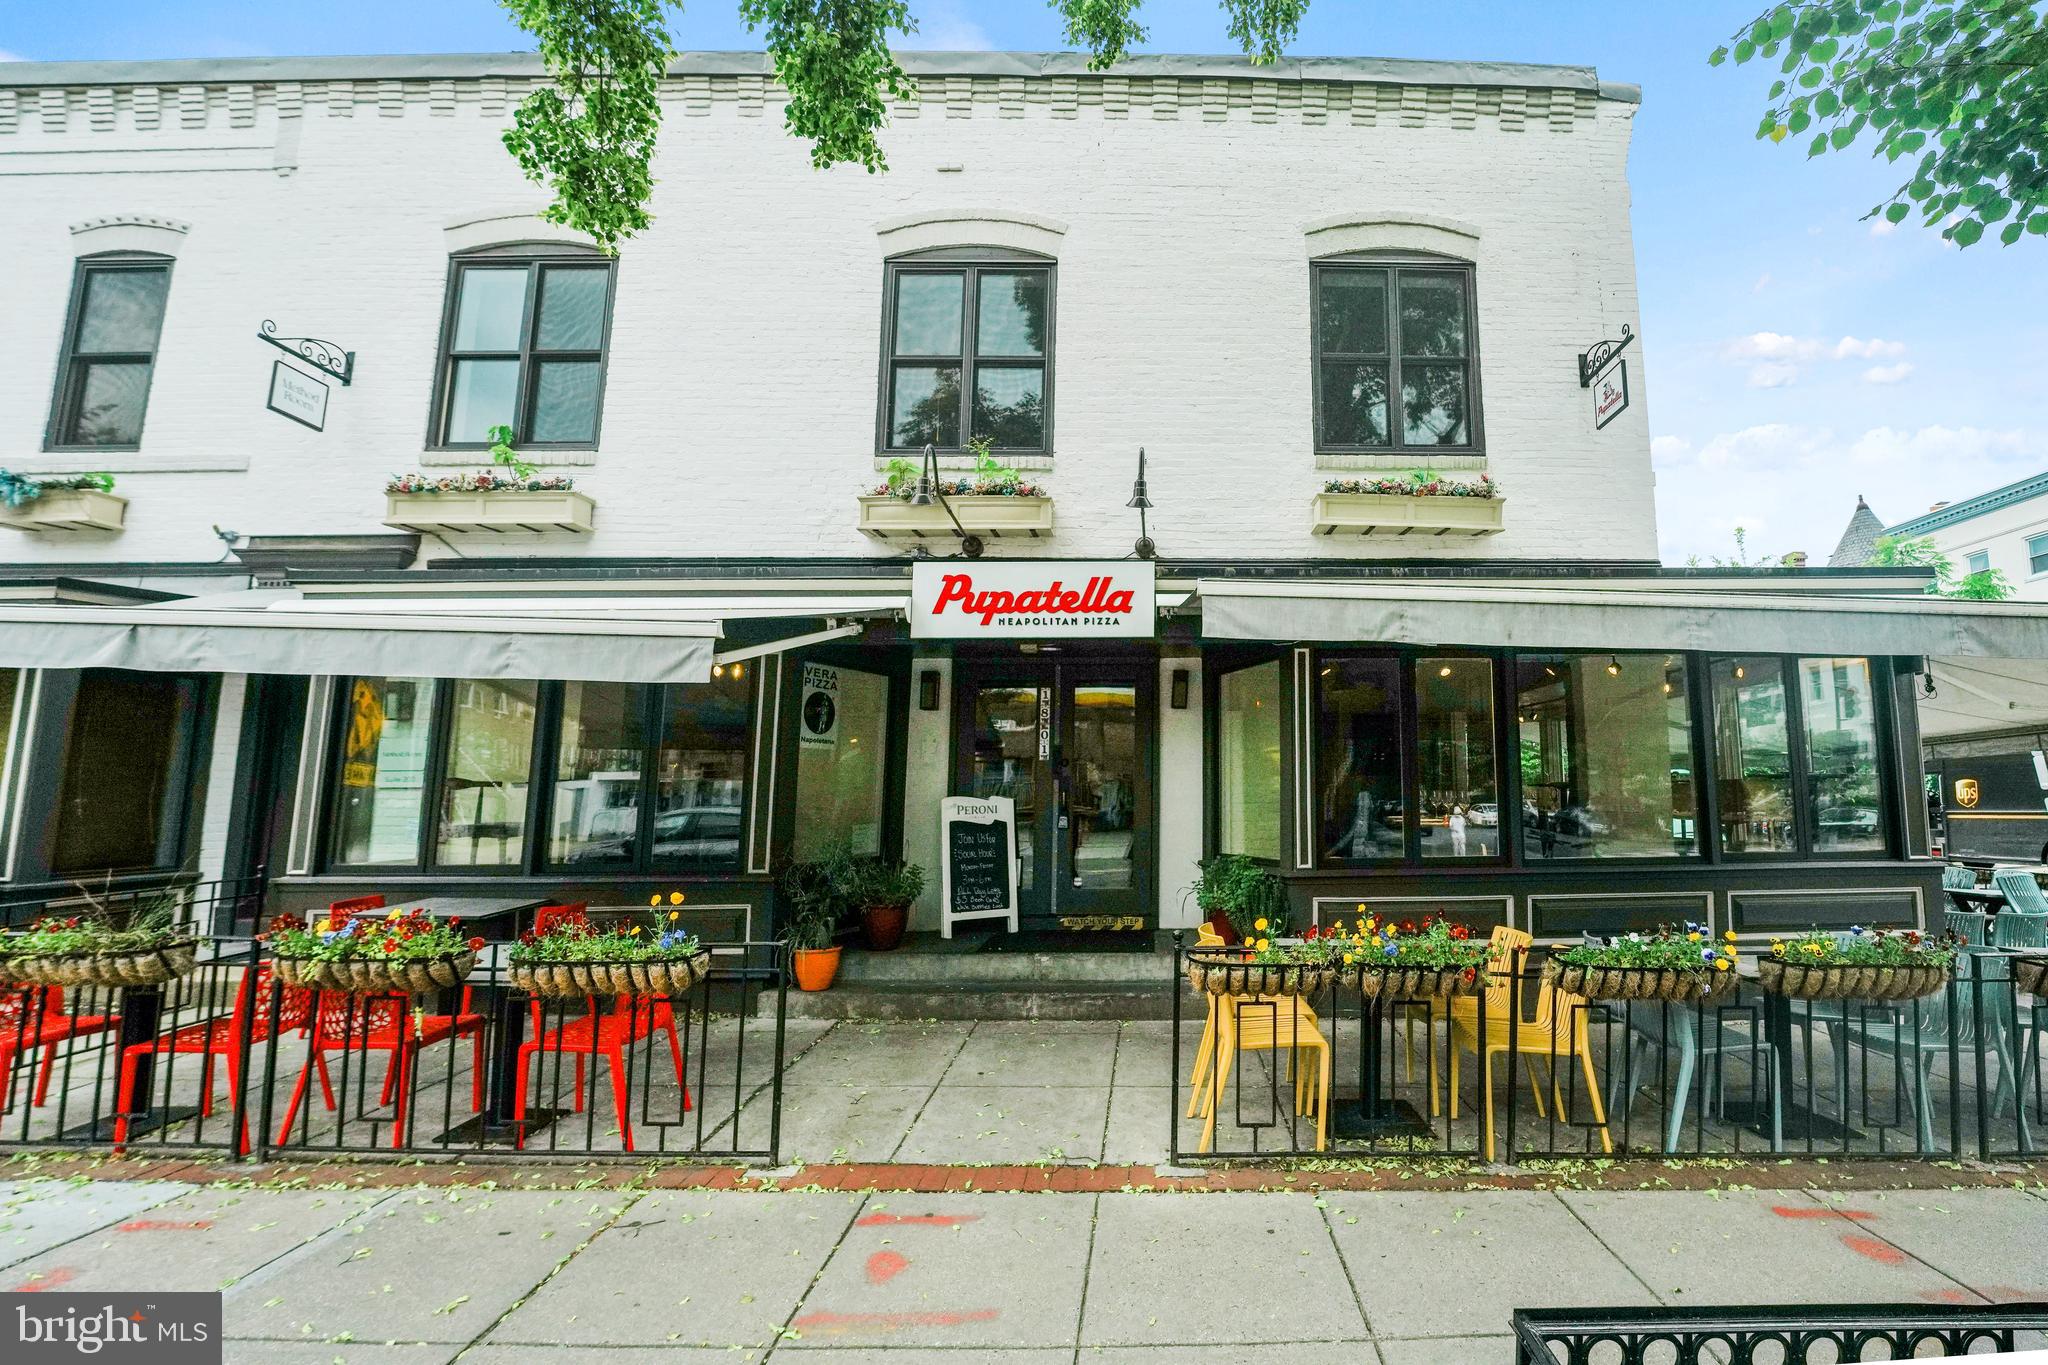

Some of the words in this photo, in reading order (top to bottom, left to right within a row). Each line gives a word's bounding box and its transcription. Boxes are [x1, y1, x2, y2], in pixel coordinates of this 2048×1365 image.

[1598, 391, 1622, 417] Pupatella
[932, 574, 1135, 625] Pupatella
[998, 617, 1078, 626] NEAPOLITAN
[1083, 617, 1120, 626] PIZZA
[804, 666, 838, 681] VERA
[804, 677, 838, 691] PIZZA
[1957, 787, 1976, 804] ups
[957, 804, 998, 816] PERONI
